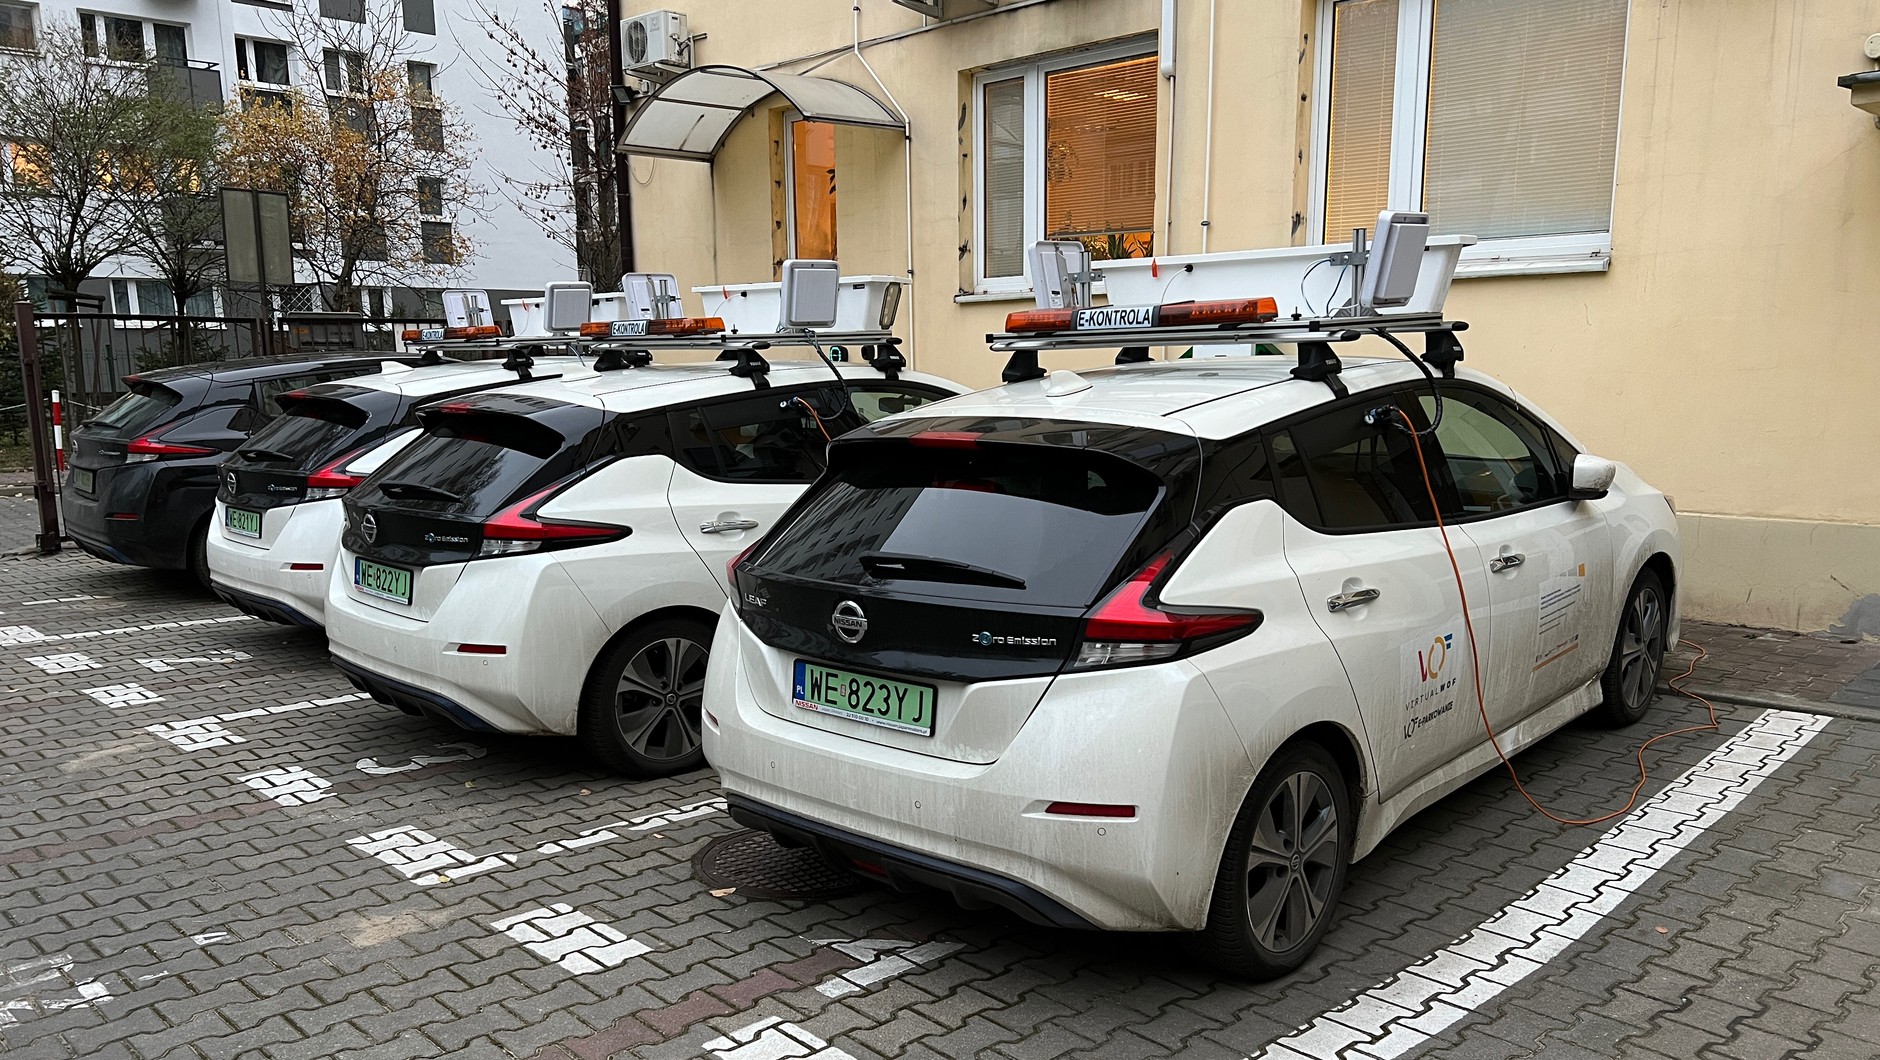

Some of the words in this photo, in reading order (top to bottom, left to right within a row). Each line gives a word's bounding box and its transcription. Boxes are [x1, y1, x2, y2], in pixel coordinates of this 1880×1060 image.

[1078, 308, 1151, 327] E-KONTROLA
[612, 322, 646, 336] E-KONTROLA
[744, 594, 767, 608] LEAF
[833, 617, 863, 628] NISSAN
[810, 667, 838, 706] WE
[847, 676, 924, 724] 823YJ
[795, 700, 818, 711] NISSAN
